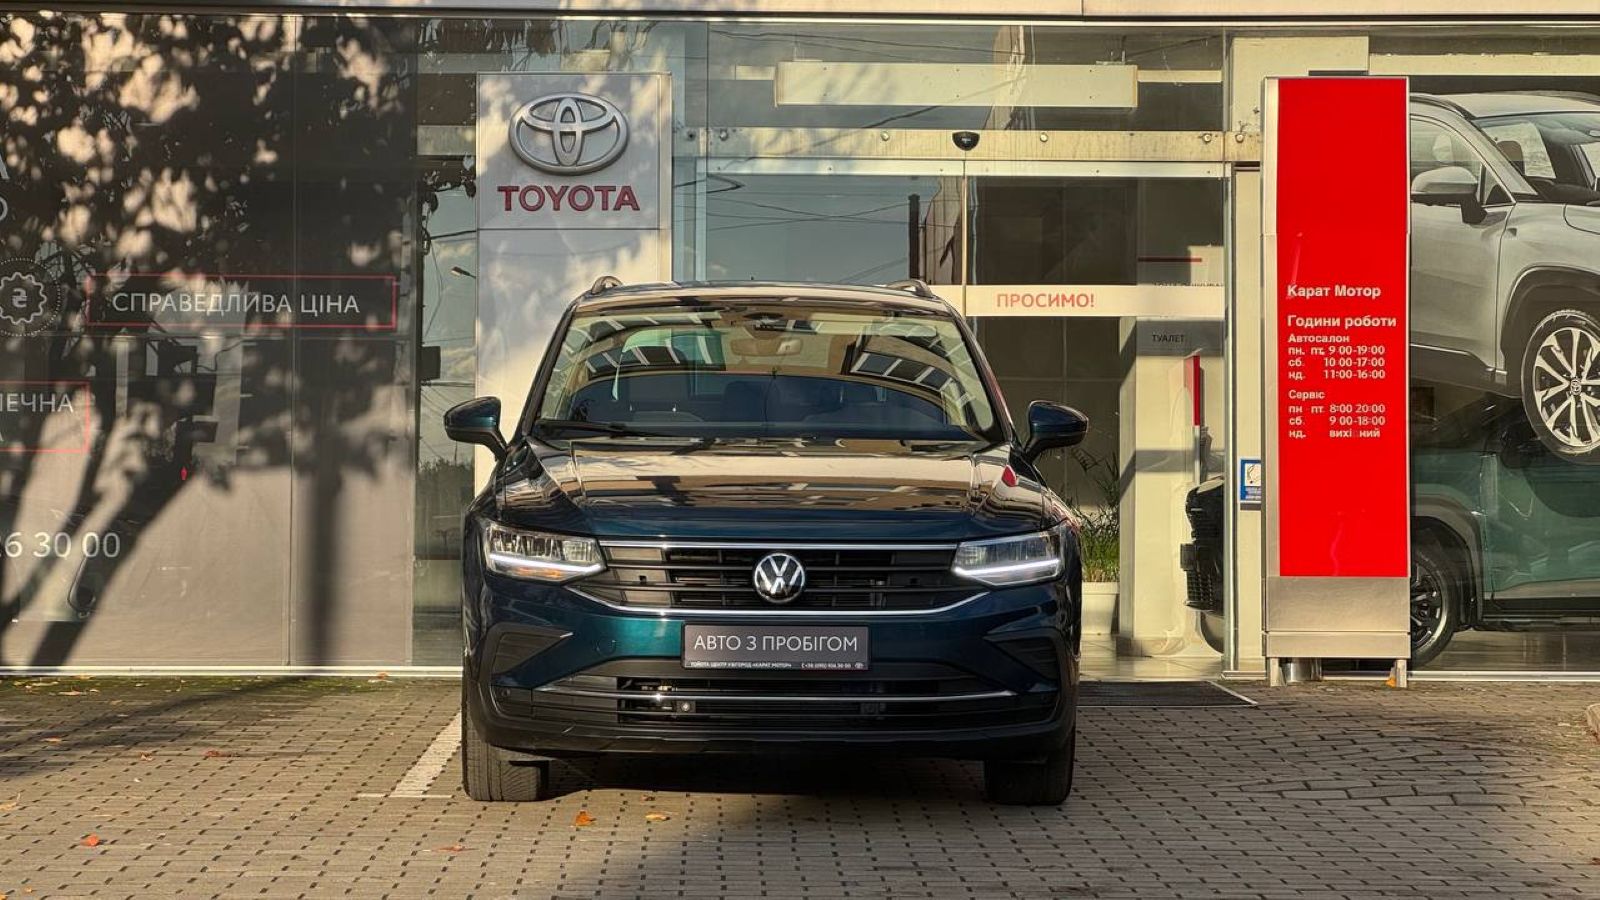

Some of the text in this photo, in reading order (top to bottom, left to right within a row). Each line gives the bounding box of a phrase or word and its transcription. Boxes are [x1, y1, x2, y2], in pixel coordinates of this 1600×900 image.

[497, 184, 640, 211] TOYOTA
[1287, 285, 1381, 299] Карат Мотор
[112, 292, 361, 317] СПРАВЕДЛИВА ЦІНА
[996, 293, 1095, 308] ПРОСИМО!
[1287, 315, 1397, 329] Години роботи
[1151, 334, 1185, 343] ТУАЛЕТ
[1287, 333, 1350, 343] Автосалон
[1288, 390, 1326, 401] Сервіс
[0, 392, 74, 414] ЕЧНА
[1329, 428, 1381, 438] вихіний
[0, 531, 120, 558] 6 30 00
[694, 634, 742, 651] АВТО
[762, 635, 858, 652] ПРОБІГОМ
